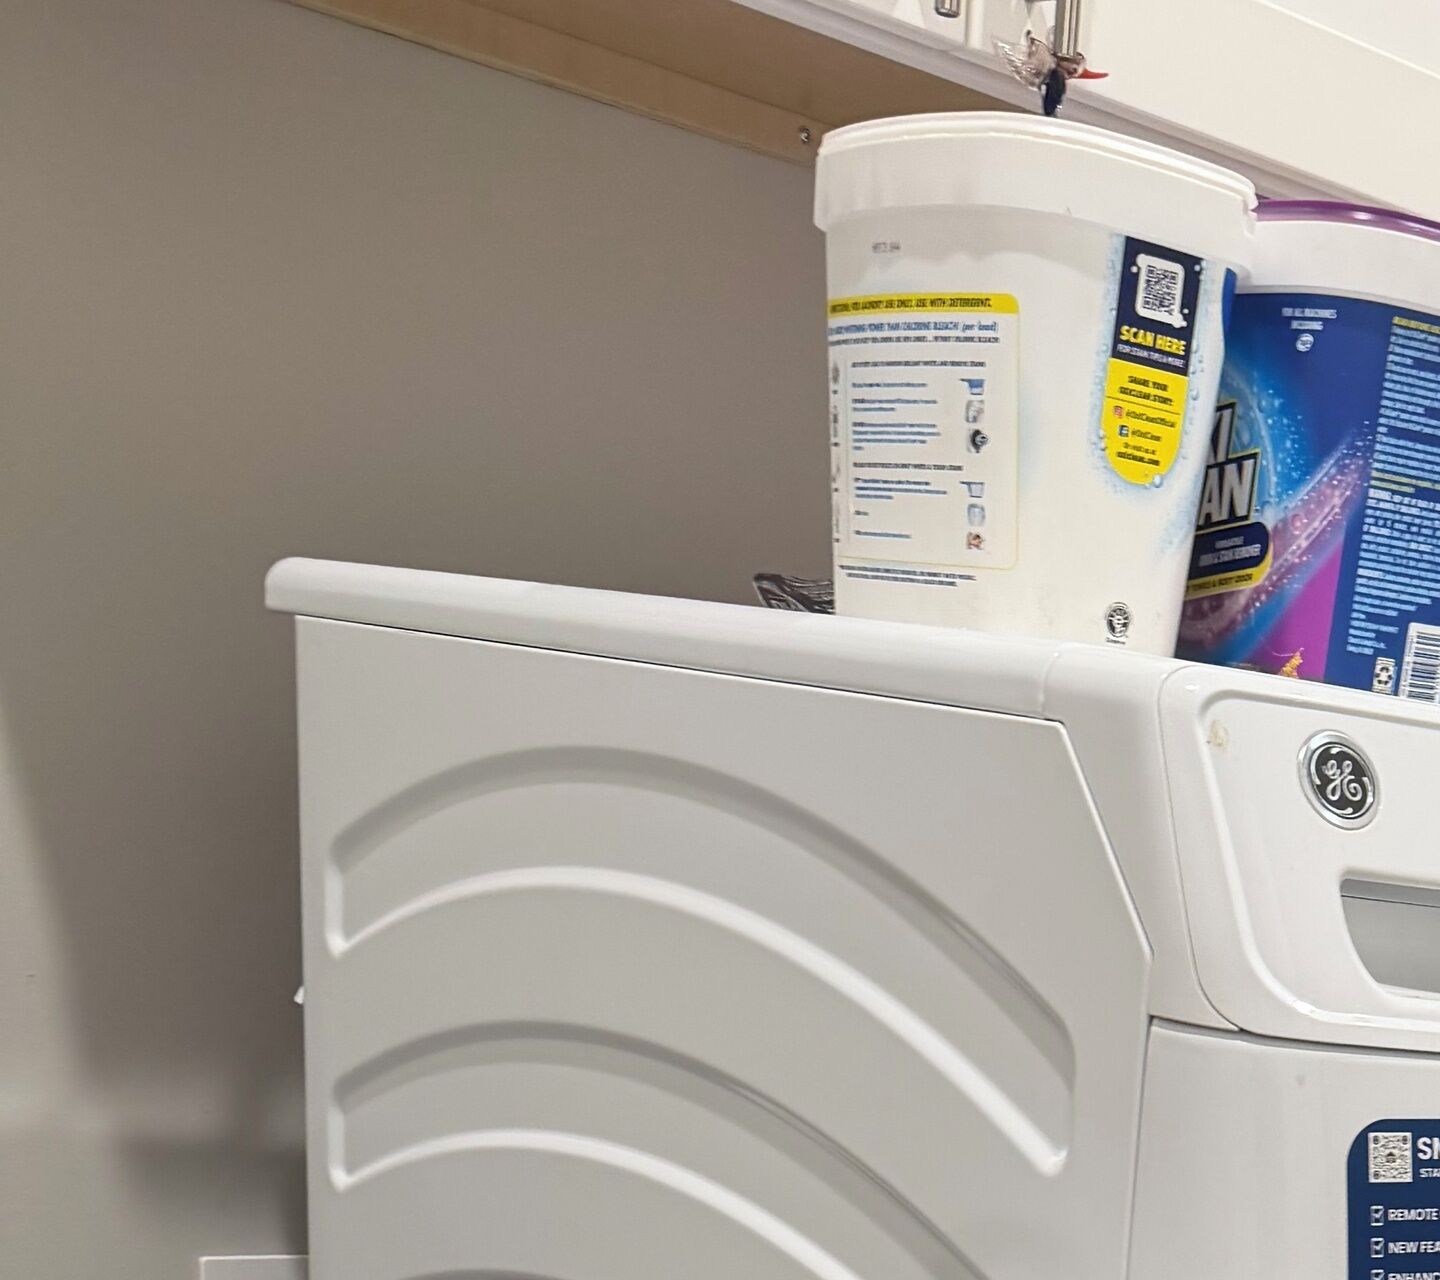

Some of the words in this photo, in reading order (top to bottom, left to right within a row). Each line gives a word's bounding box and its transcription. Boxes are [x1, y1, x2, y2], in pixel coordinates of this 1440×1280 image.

[1119, 325, 1155, 348] SCAN
[1155, 334, 1187, 356] HERE
[1388, 1207, 1438, 1221] REMOTE
[1388, 1241, 1418, 1254] NEW
